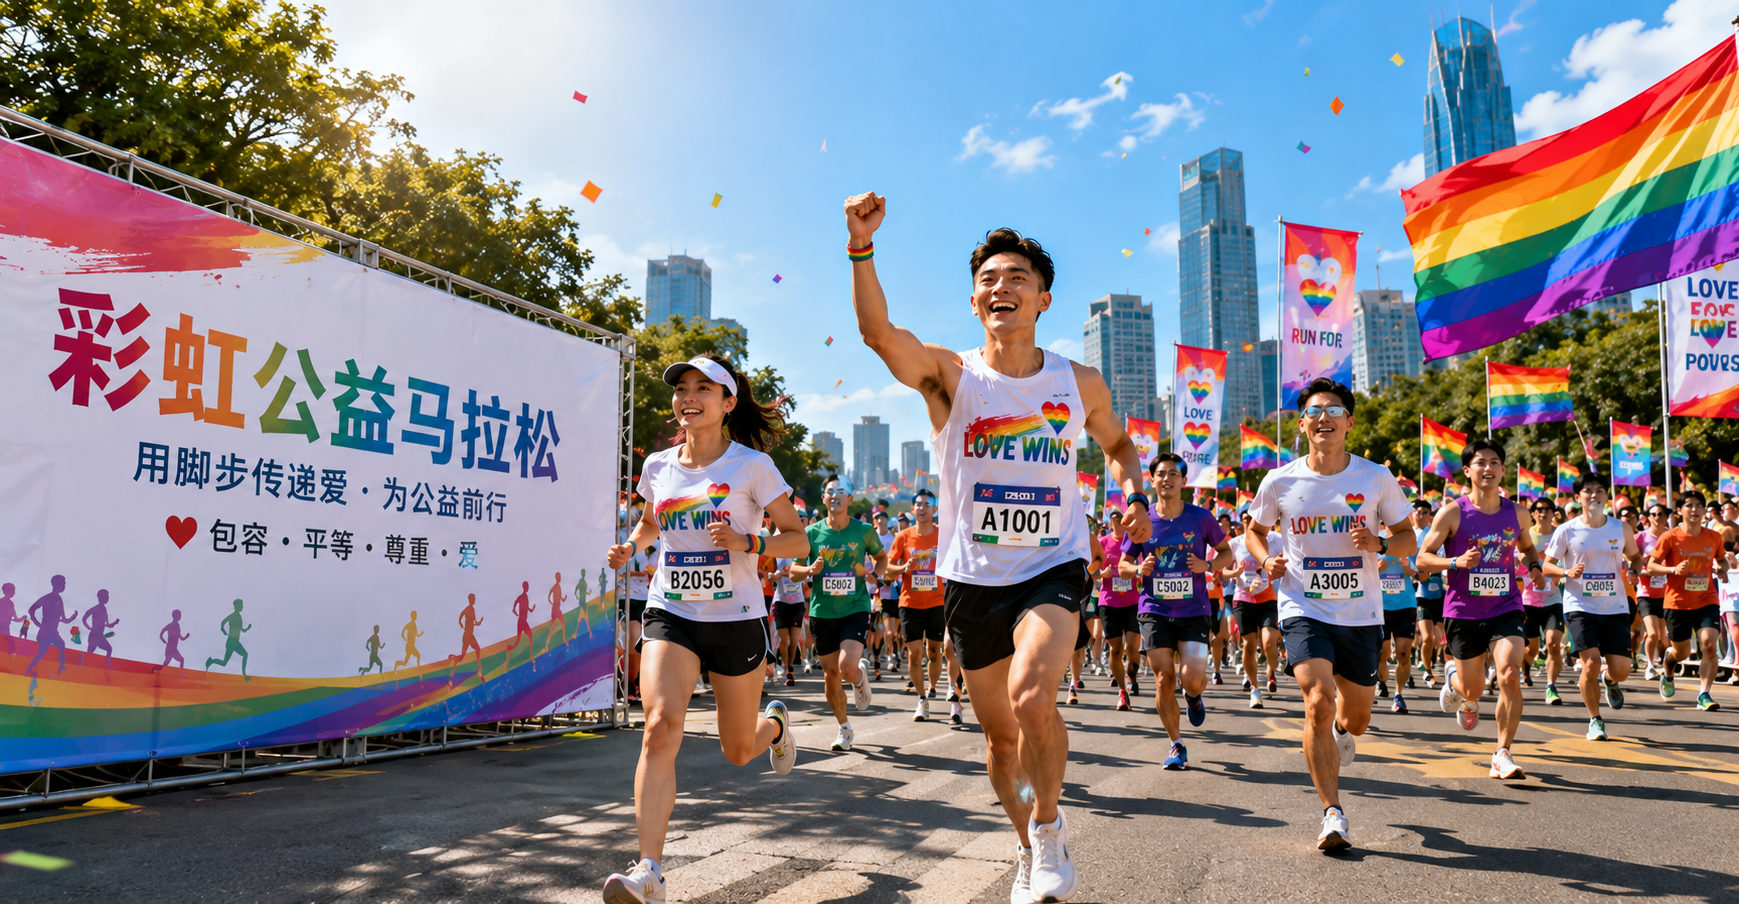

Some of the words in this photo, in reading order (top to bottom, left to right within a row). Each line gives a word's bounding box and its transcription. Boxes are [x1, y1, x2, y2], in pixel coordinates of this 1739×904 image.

[1687, 276, 1739, 299] LOVE
[1292, 327, 1317, 346] RUN
[1320, 331, 1342, 349] FOR
[48, 287, 560, 483] 彩虹公益马拉松
[1184, 406, 1213, 421] LOVE
[963, 431, 1018, 461] LOVE
[1021, 436, 1072, 466] WINS
[659, 510, 688, 531] OVE
[981, 506, 1051, 535] A1001
[1290, 516, 1328, 535] LOVE
[671, 569, 725, 590] B2056
[1310, 572, 1359, 590] A3005
[1473, 576, 1507, 590] B4023
